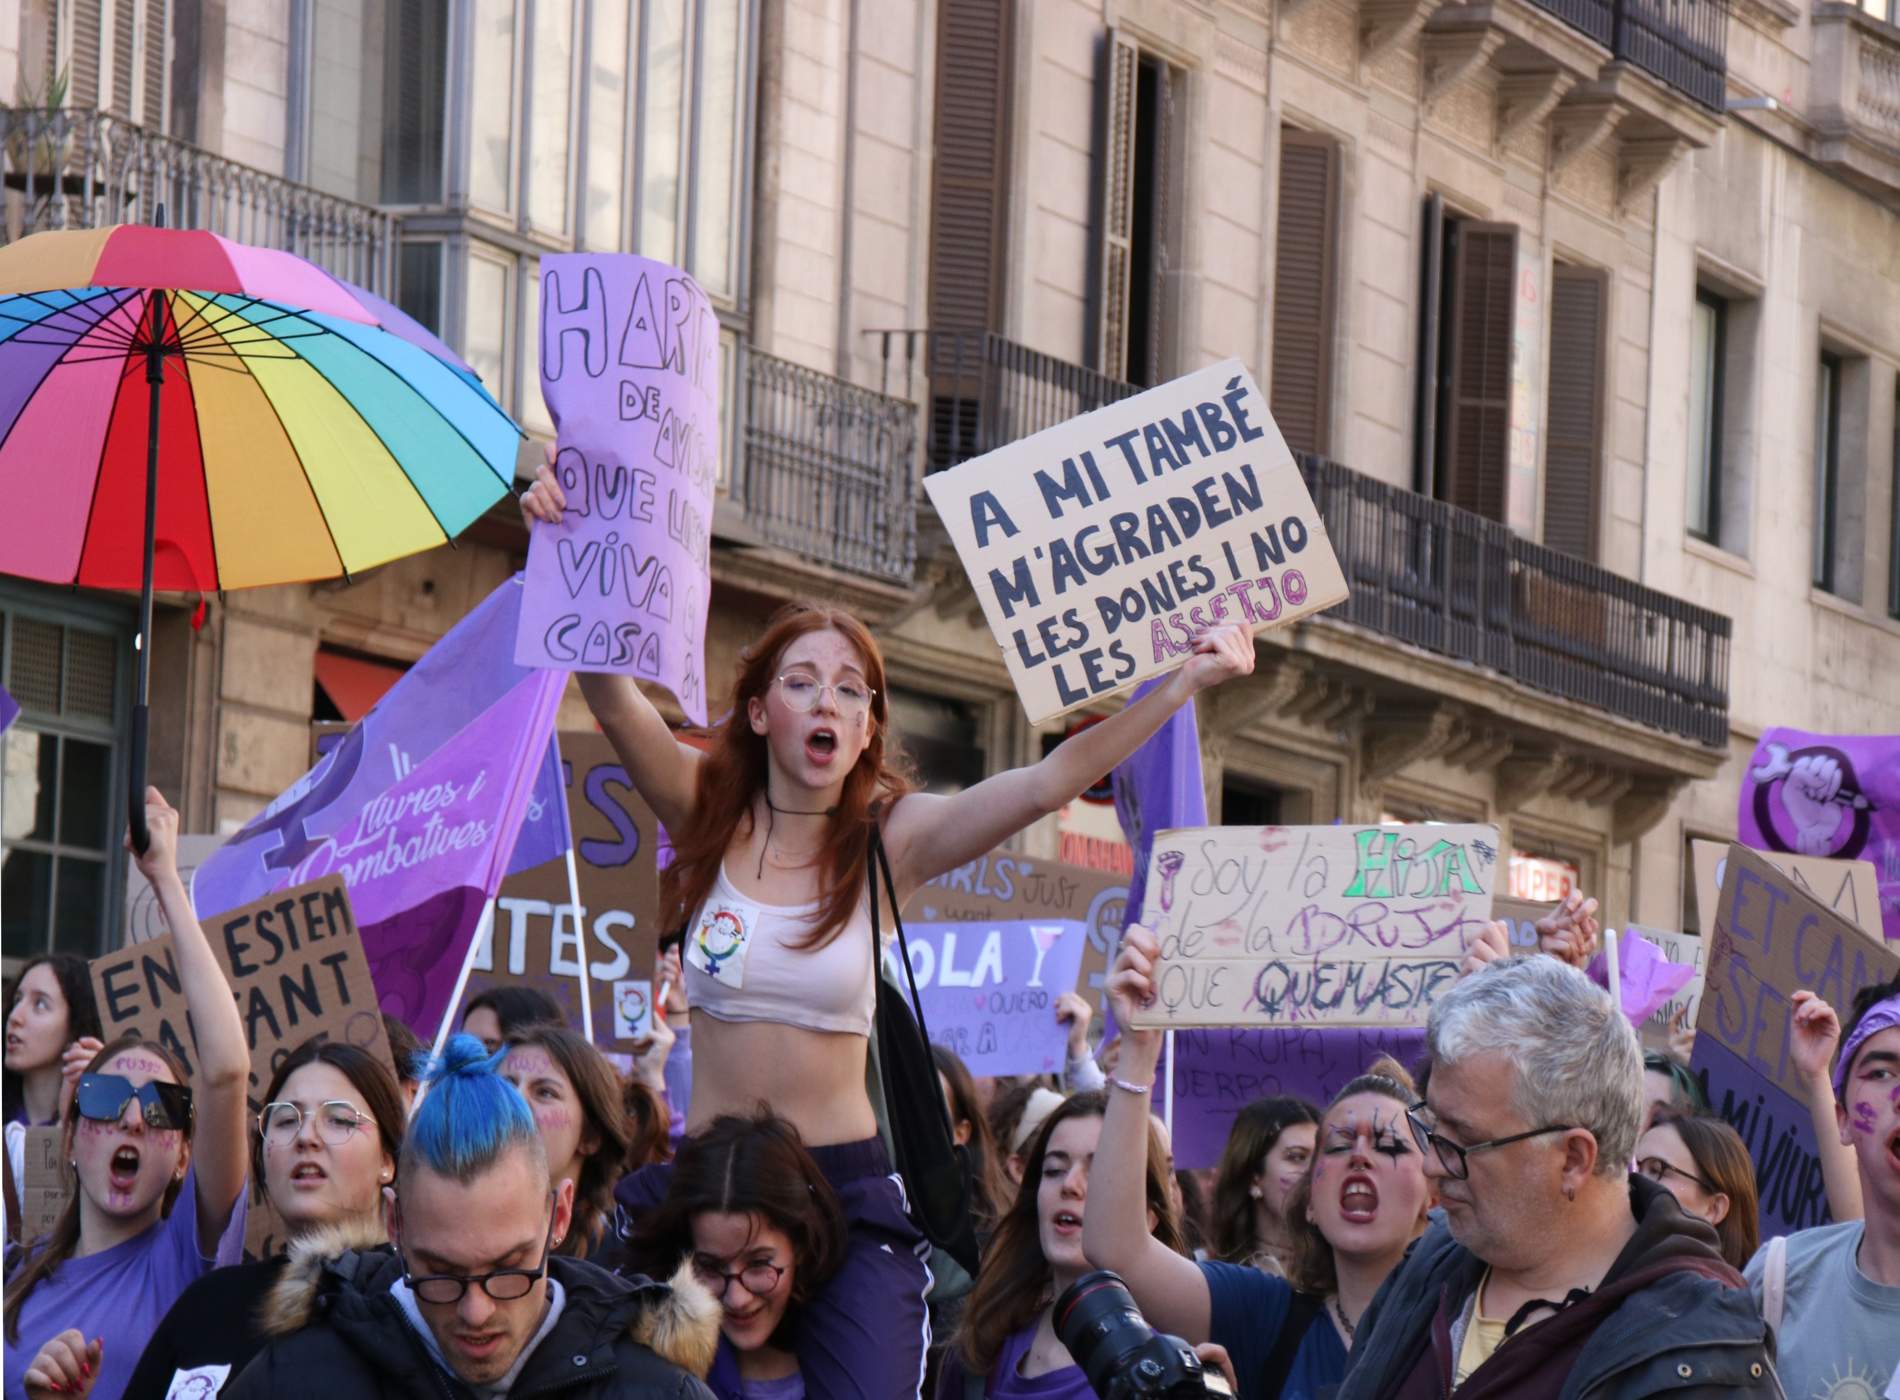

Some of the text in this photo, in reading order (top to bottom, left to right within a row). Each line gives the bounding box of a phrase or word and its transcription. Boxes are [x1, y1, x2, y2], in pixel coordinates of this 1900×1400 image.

[619, 380, 661, 422] DE
[555, 447, 656, 523] QUE
[970, 376, 1264, 548] A MI TAMBÉ
[989, 464, 1264, 618] M'AGRADEN
[1013, 516, 1308, 669] LES DONES I NO
[544, 614, 660, 677] CASA
[1053, 569, 1308, 706] LES ASSETJO
[467, 770, 486, 801] i
[926, 855, 1015, 901] RLS
[1191, 838, 1268, 922] Soy
[1286, 832, 1329, 898] la
[1731, 866, 1790, 956] ET
[224, 887, 350, 978] ESTEM
[1243, 890, 1278, 954] la
[1160, 965, 1229, 1017] QUE
[1174, 1069, 1282, 1099] UERPO
